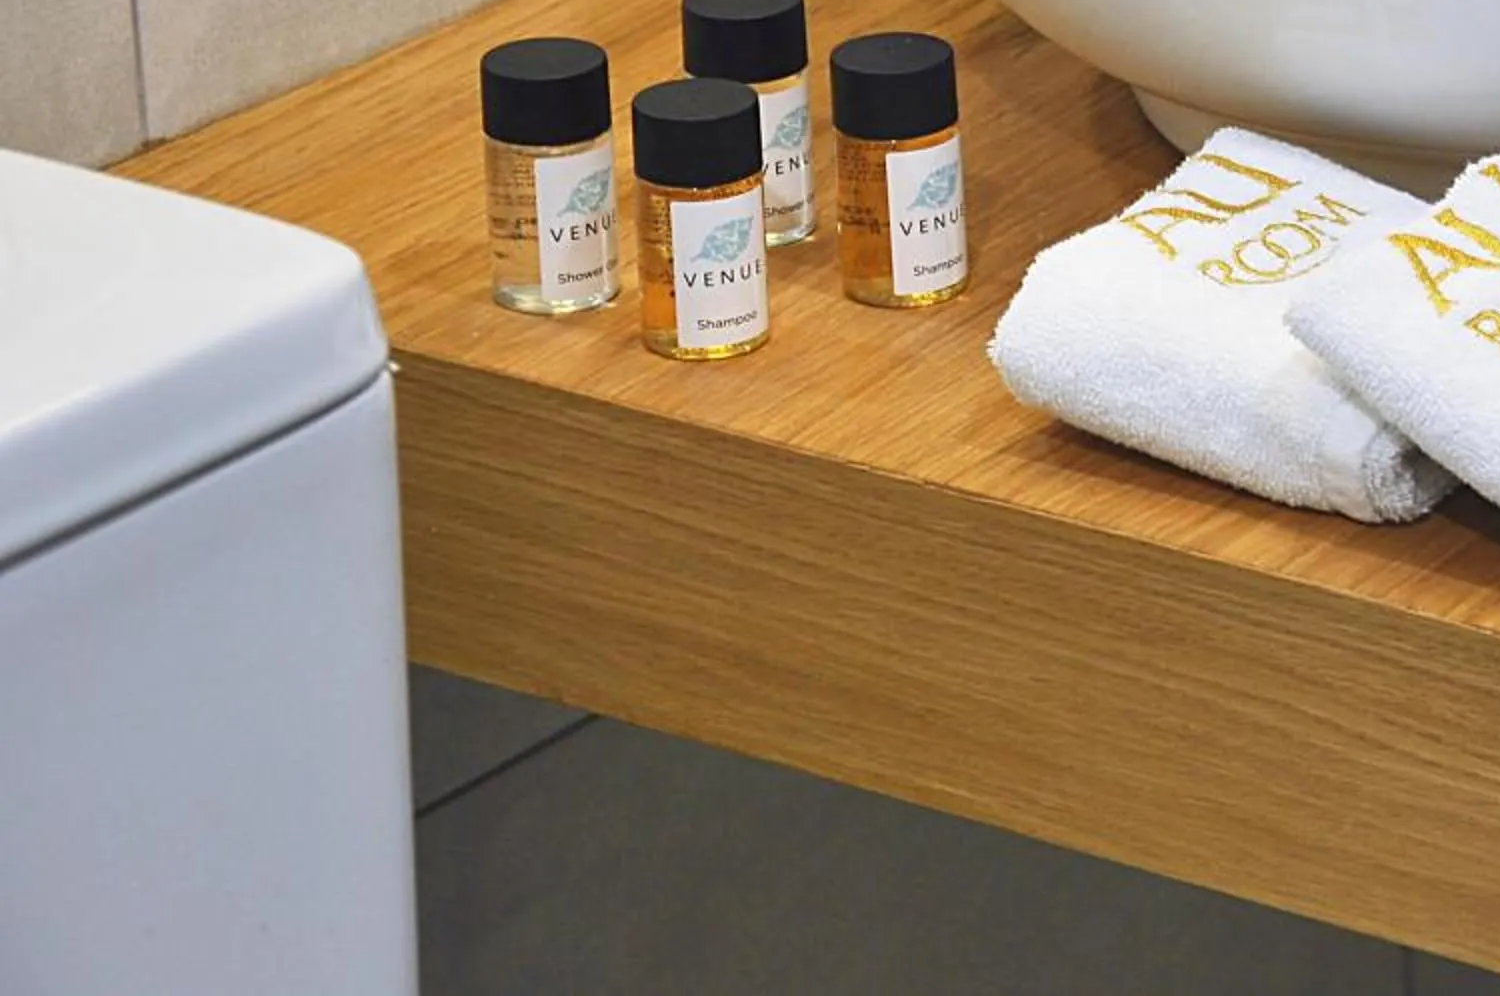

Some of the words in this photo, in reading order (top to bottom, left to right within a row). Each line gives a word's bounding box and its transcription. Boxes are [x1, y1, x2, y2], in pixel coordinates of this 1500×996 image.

[1195, 192, 1368, 288] ROOM
[557, 264, 604, 285] Shower
[683, 258, 767, 288] VENUE
[697, 309, 758, 331] Shampoo
